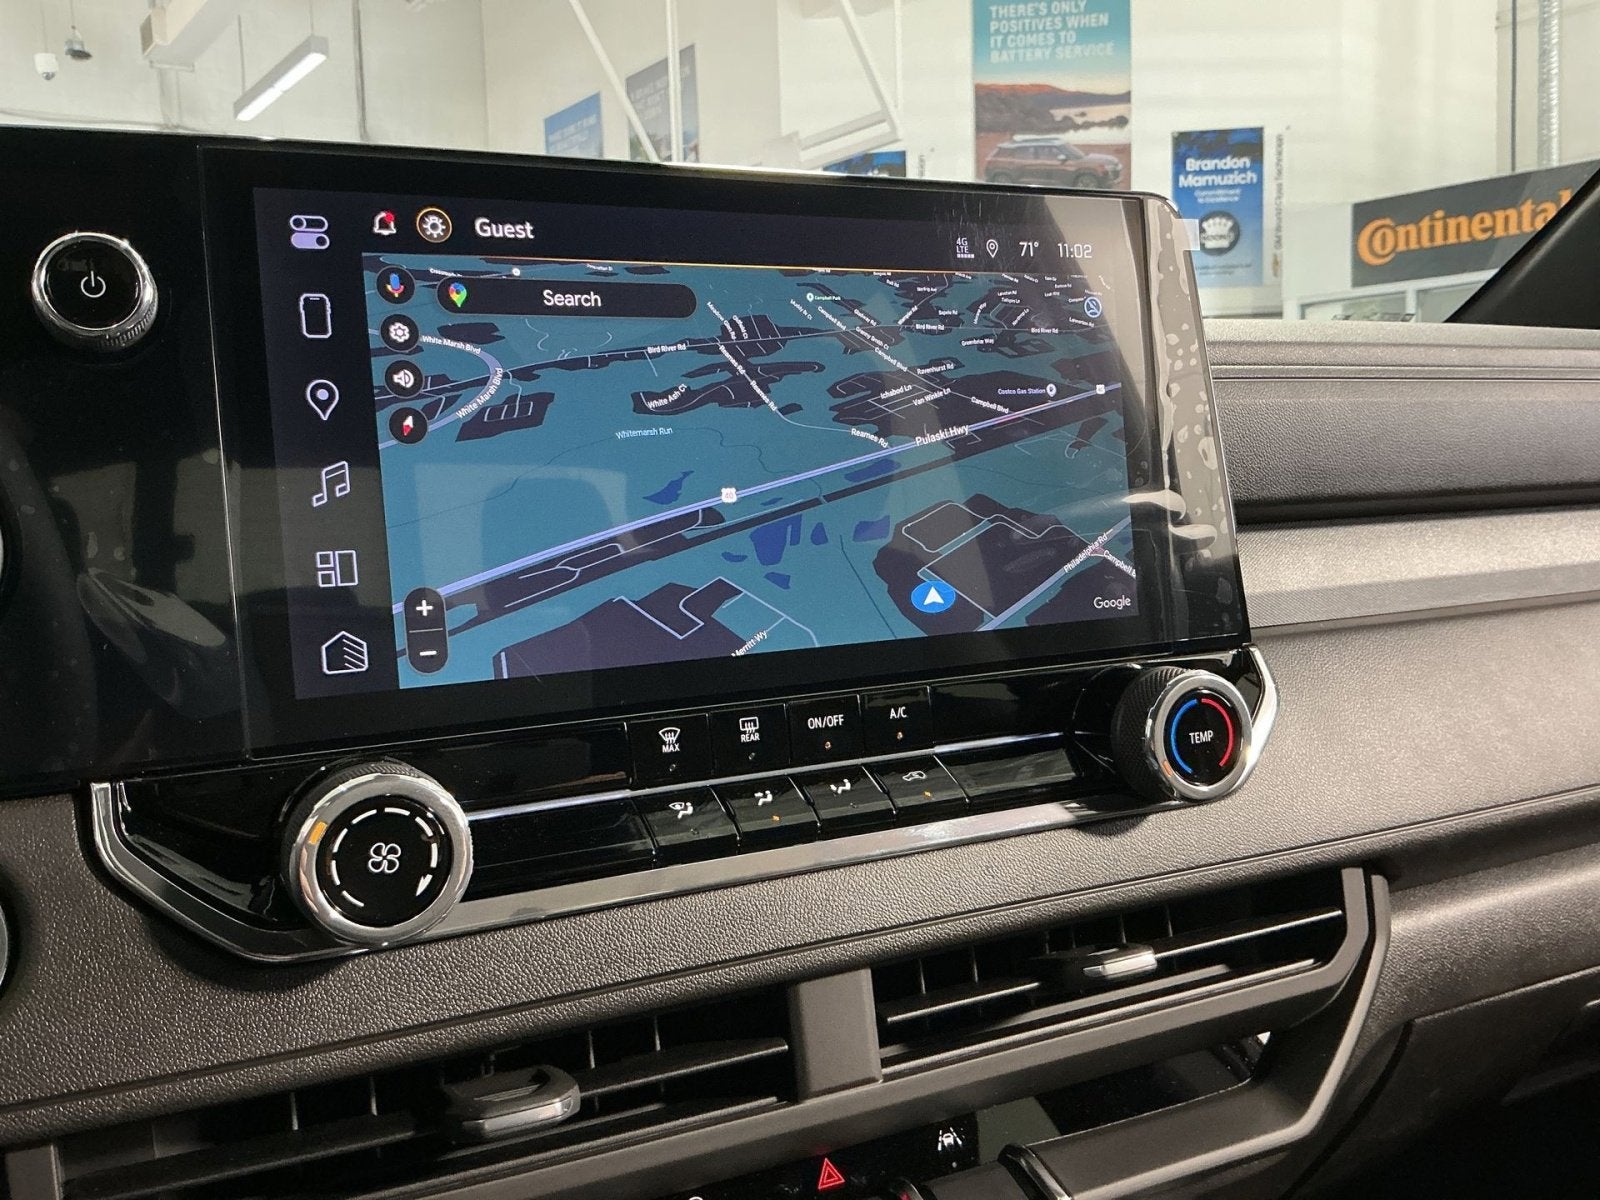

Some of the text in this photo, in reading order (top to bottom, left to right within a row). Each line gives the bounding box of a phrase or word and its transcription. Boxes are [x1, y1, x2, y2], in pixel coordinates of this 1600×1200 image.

[989, 0, 1087, 18] THERE'S ONLY
[990, 13, 1109, 33] POSITIVES WHEN
[990, 31, 1076, 48] IT COMES TO
[990, 42, 1114, 63] BATTERY SERVICE
[1186, 156, 1250, 171] Brandon
[1178, 171, 1257, 188] Mamuzich
[475, 217, 534, 239] Guest
[956, 237, 968, 246] 4G
[1019, 241, 1039, 256] 71°
[1057, 243, 1092, 258] 11:02
[543, 289, 602, 307] Search
[818, 306, 838, 324] Campbell
[422, 335, 481, 355] White Marsh Blvd
[647, 342, 686, 354] Bird River Rd
[719, 344, 738, 367] Reames
[875, 347, 908, 372] Campbell Blvd
[917, 363, 954, 375] Ravenhurst Rd
[456, 367, 504, 418] White Marsh Blvd
[648, 383, 688, 410] White Ash Ct
[750, 380, 770, 404] Reames
[880, 384, 913, 400] Ichabod Ln
[912, 387, 951, 406] Van Winkle Ln
[971, 396, 1009, 414] Campbell Blvd
[615, 427, 673, 440] Whitemarsh Run
[851, 428, 889, 448] Reames Rd
[915, 424, 969, 447] Pulaski Hwy
[1063, 532, 1108, 574] Philadelphia Rd
[1103, 549, 1132, 574] Campbell
[1093, 595, 1131, 610] Google
[754, 630, 767, 642] Wy
[807, 715, 845, 730] ON/OFF
[890, 707, 908, 720] A/C
[740, 732, 761, 743] REAR
[1189, 730, 1214, 744] TEMP
[662, 743, 680, 753] MAX
